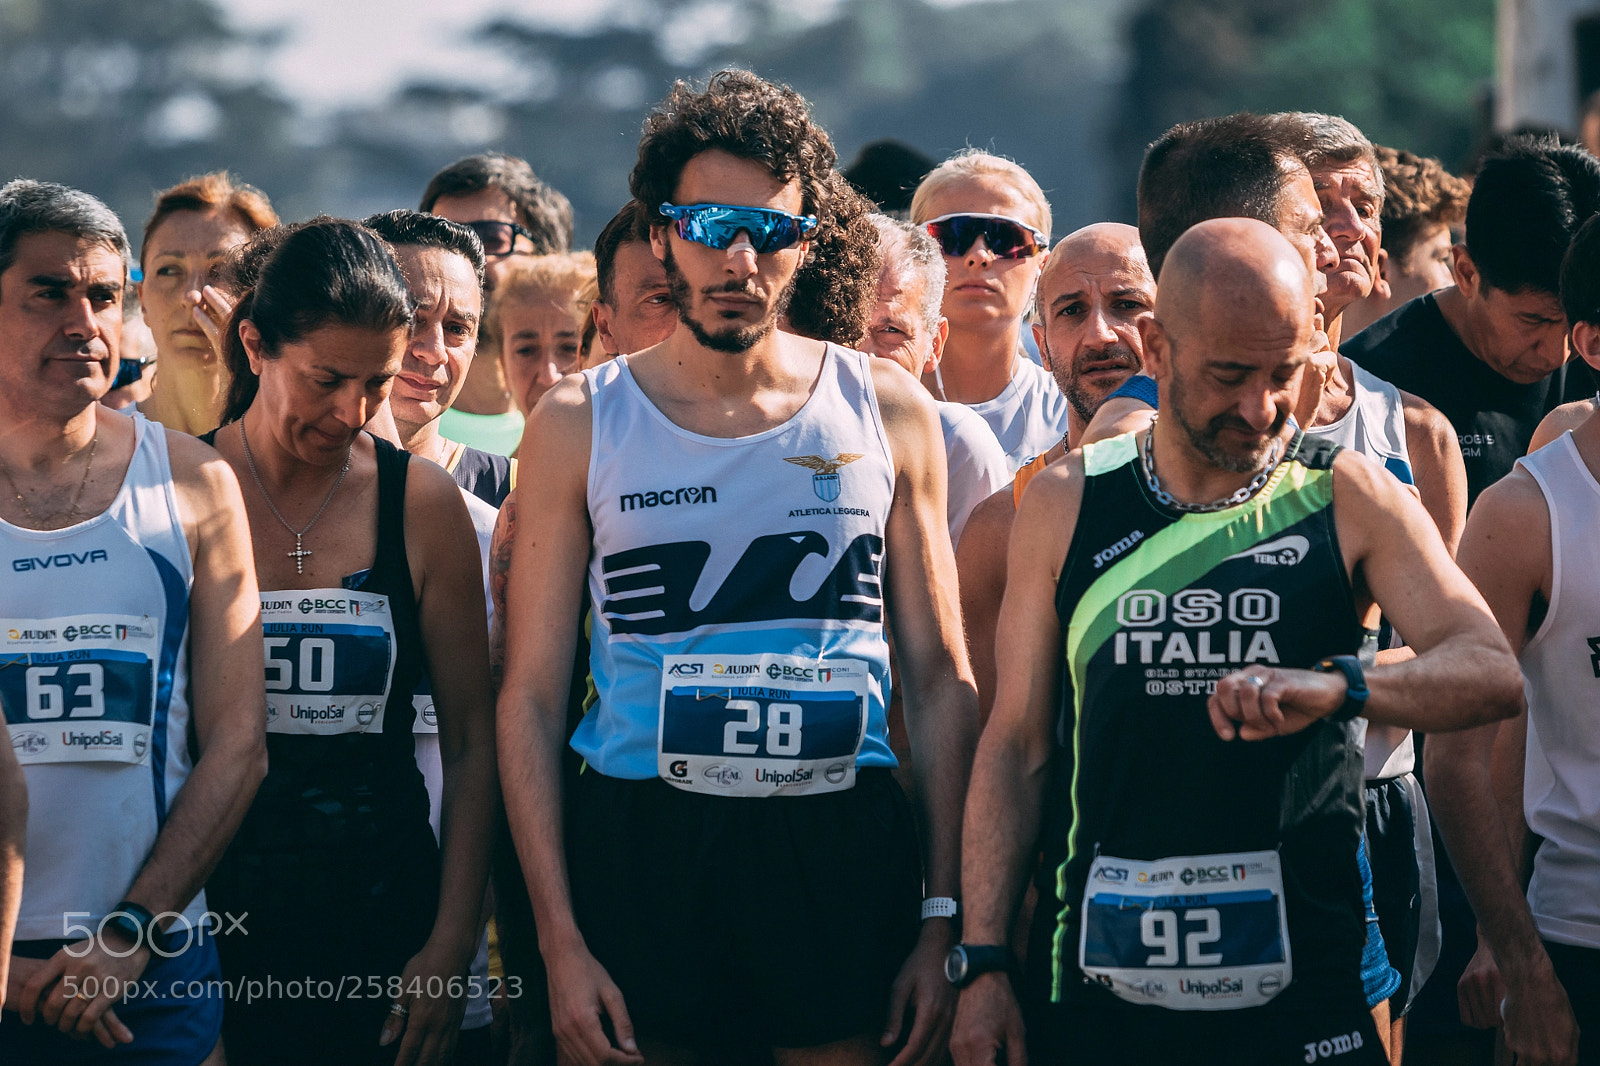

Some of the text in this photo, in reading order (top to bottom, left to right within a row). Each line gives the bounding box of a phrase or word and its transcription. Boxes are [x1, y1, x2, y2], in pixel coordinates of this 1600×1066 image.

[1457, 434, 1495, 445] ROGI'S
[1462, 447, 1481, 457] AM
[620, 486, 717, 512] macron
[788, 507, 870, 517] ATLETICA LEGGERA
[1093, 530, 1145, 569] Joma
[12, 549, 108, 572] GIVOVA
[314, 600, 346, 609] BCC
[1116, 588, 1280, 627] OSO
[20, 629, 57, 640] AUDIN
[80, 625, 111, 635] BCC
[270, 623, 323, 633] IULIA RUN
[68, 650, 91, 660] RUN
[1114, 631, 1281, 665] ITALIA
[263, 637, 335, 691] 50
[668, 663, 704, 675] ACSI
[724, 664, 760, 675] AUDIN
[783, 666, 813, 677] BCC
[1145, 669, 1180, 678] OLD
[25, 663, 105, 719] 63
[738, 687, 791, 700] IULIA RUN
[1145, 680, 1218, 696] OSTI
[290, 704, 345, 724] UnipolSai
[723, 700, 803, 756] 28
[62, 731, 123, 750] UnipolSai
[756, 768, 813, 787] UnipolSai
[1197, 867, 1228, 878] BCC
[1186, 894, 1208, 905] RUN
[1140, 908, 1223, 967] 92
[1179, 977, 1243, 999] UnipolSai
[1304, 1030, 1363, 1064] Joma
